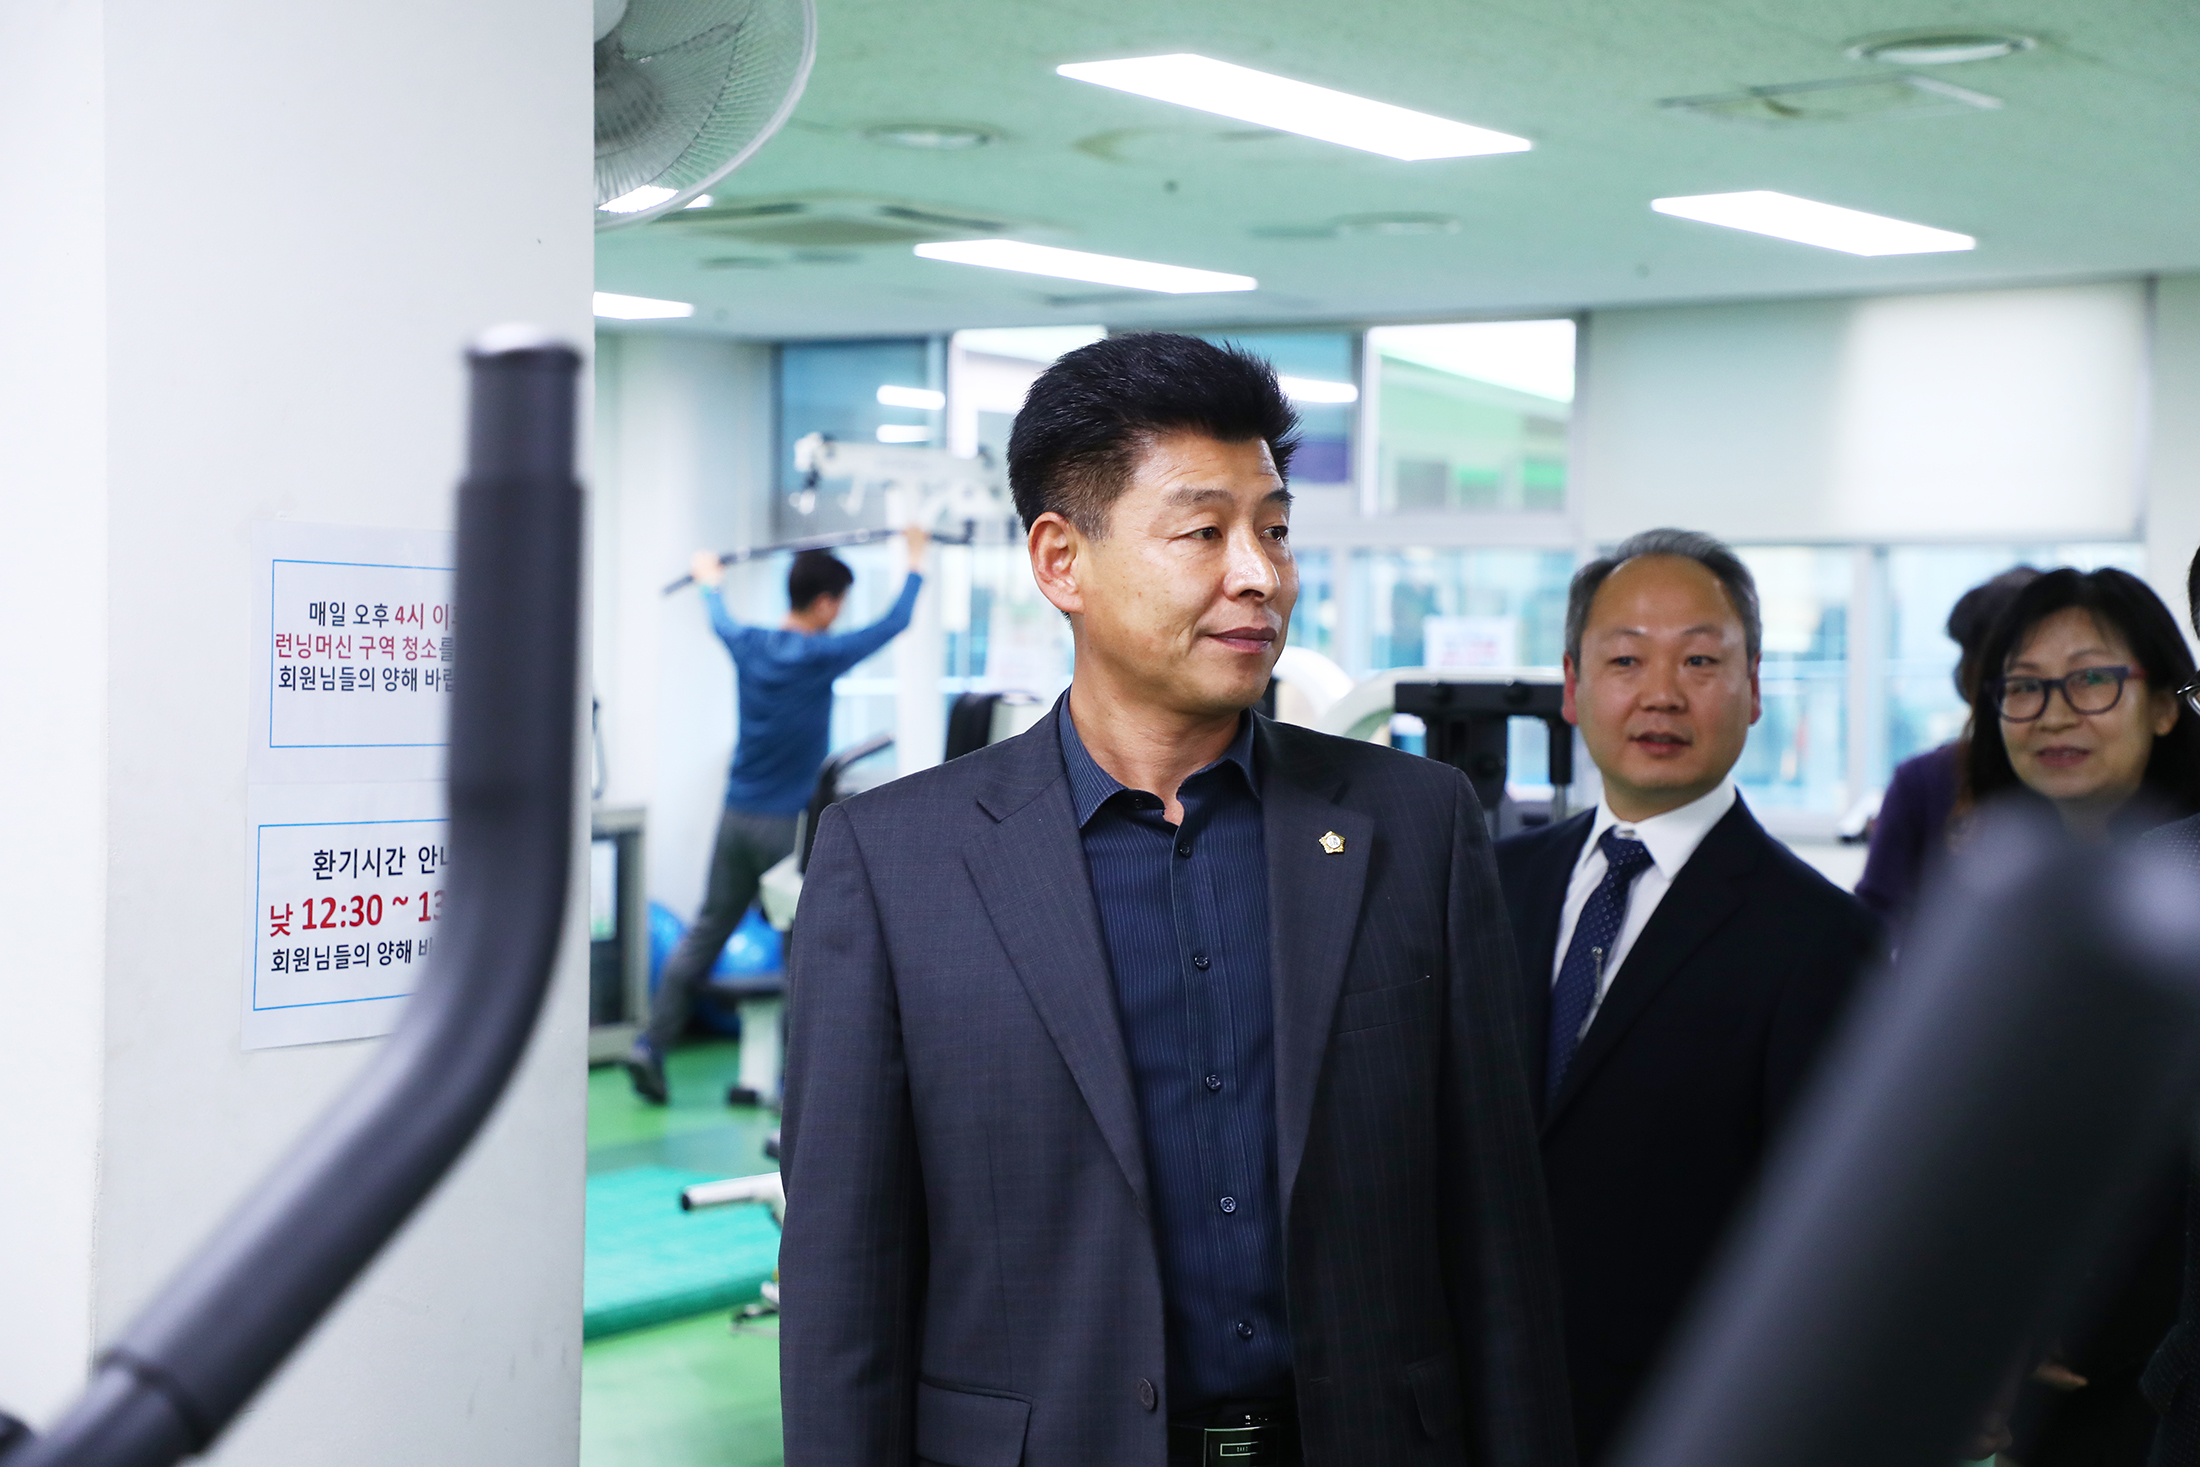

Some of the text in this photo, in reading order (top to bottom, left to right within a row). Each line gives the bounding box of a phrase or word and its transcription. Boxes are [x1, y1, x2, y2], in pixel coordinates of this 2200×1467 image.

[309, 601, 457, 631] 매일 오후 4시 이
[275, 633, 352, 660] 런닝머신
[359, 636, 396, 661] 구역
[278, 665, 375, 692] 회원님들의
[382, 667, 418, 692] 양해
[313, 846, 406, 880] 환기시간
[270, 903, 294, 937] 낮
[302, 894, 383, 930] 12:30
[270, 942, 370, 974] 회원님들의
[377, 939, 412, 965] 양해
